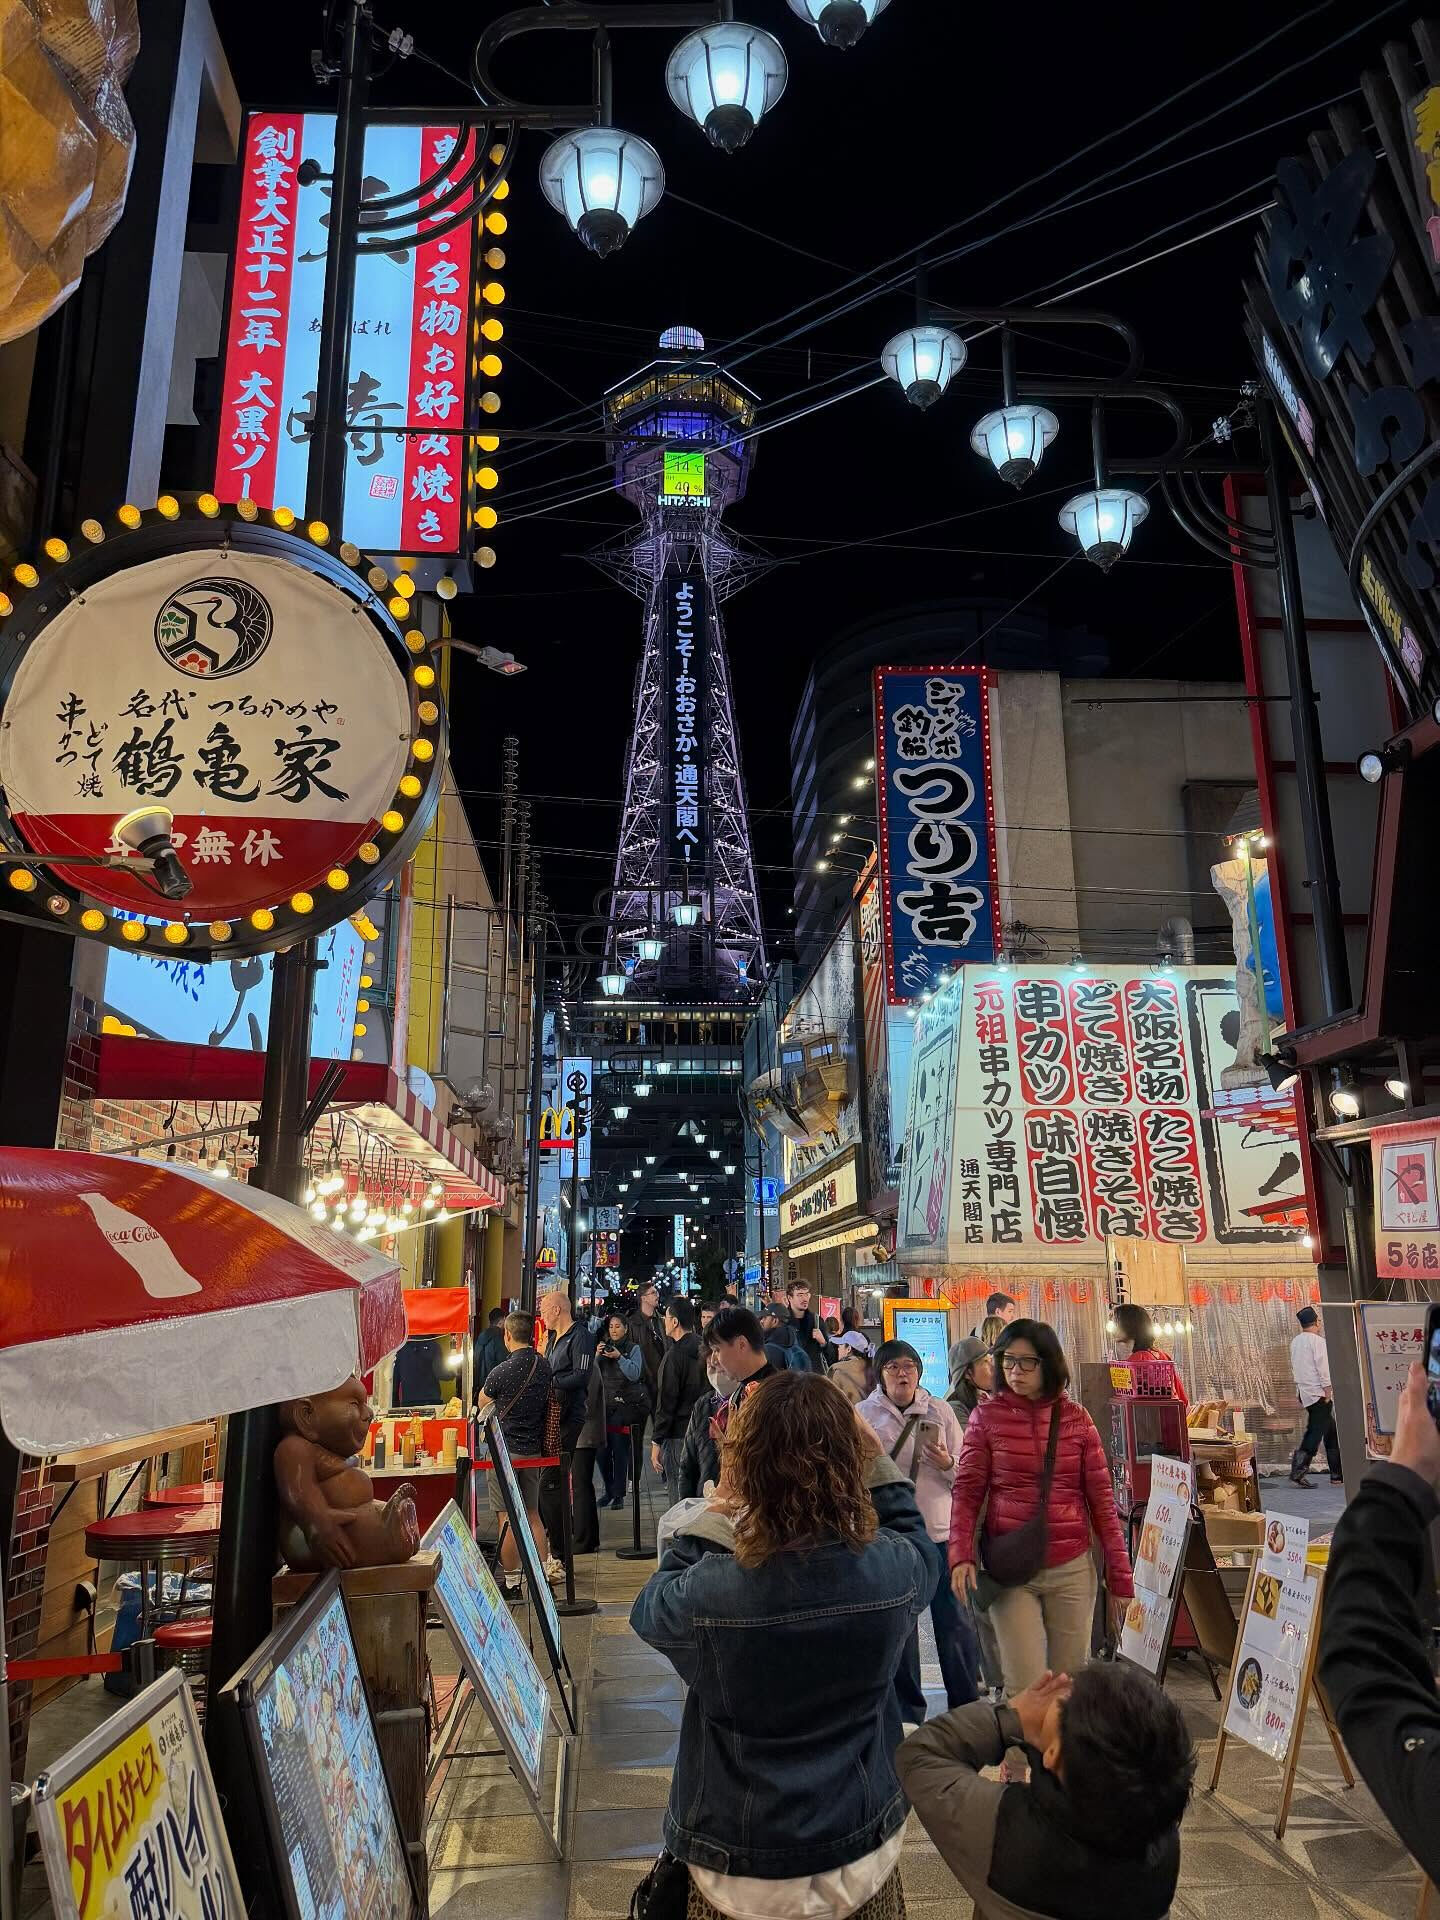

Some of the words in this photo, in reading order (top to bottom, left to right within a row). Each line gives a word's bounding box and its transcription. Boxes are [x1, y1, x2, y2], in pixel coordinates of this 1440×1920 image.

[238, 125, 296, 355] 創業大正十二年
[657, 495, 711, 507] HITACHI
[54, 692, 87, 768] 串かつ
[73, 720, 109, 798] どて焼
[111, 718, 350, 804] 鶴亀家
[207, 695, 339, 725] つるかめや
[893, 762, 984, 947] つり吉
[1016, 983, 1068, 1104] 串カツ
[1074, 981, 1129, 1103] どて焼き
[1128, 982, 1185, 1103] 大阪名物
[105, 1225, 160, 1244] Coca-Cola
[960, 1158, 984, 1244] 通天閣店
[1027, 1114, 1087, 1241] 味自慢
[1085, 1111, 1145, 1239] 焼きそば
[1146, 1113, 1200, 1241] たこ焼き
[1387, 1241, 1439, 1269] 5号店
[62, 1742, 160, 1920] タイムサービス
